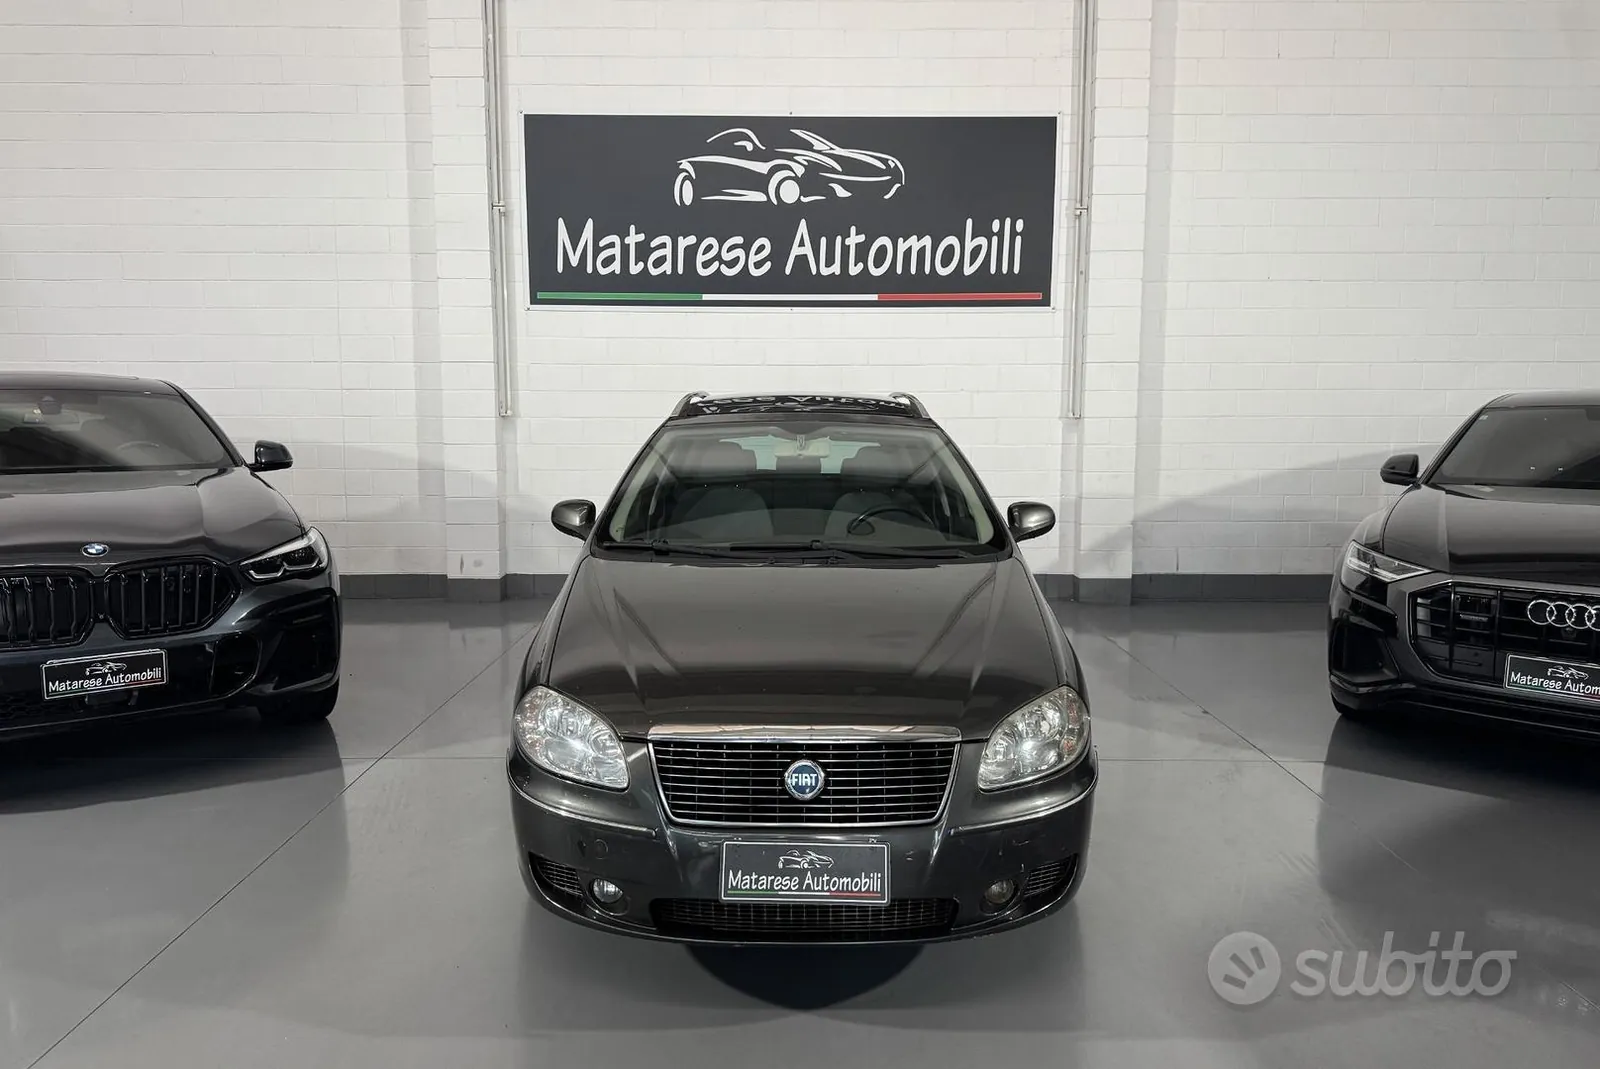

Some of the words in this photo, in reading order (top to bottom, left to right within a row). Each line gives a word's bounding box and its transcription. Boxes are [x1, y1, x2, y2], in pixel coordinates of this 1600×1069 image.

[556, 217, 772, 277] Matarese
[785, 217, 1023, 276] Automobili
[49, 679, 102, 692] Matarese
[105, 667, 162, 685] Automobili
[1510, 671, 1562, 690] Matarese
[792, 773, 817, 786] FIAT
[728, 870, 798, 890] Matarese
[803, 871, 882, 892] Automobili
